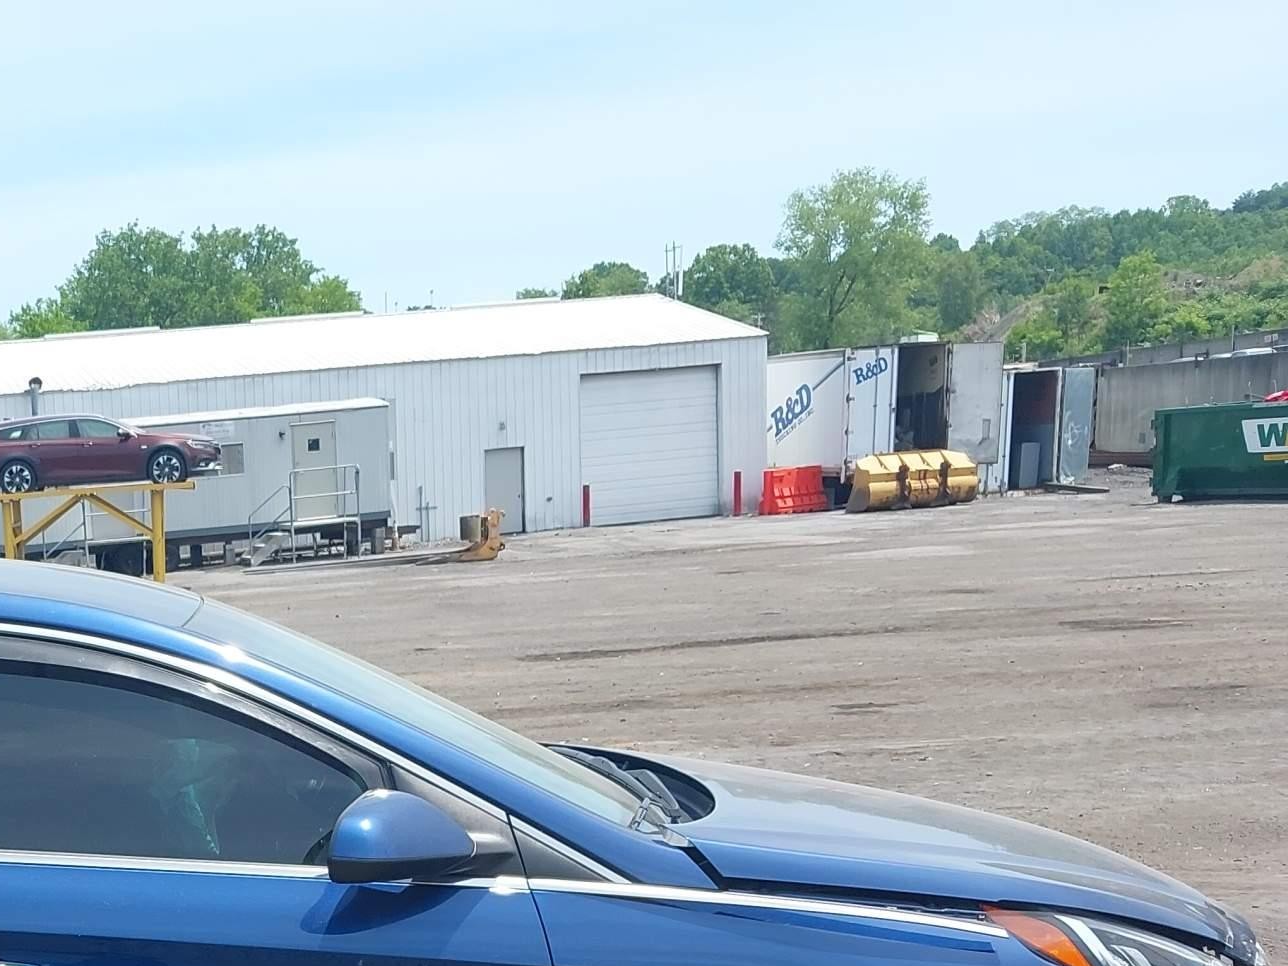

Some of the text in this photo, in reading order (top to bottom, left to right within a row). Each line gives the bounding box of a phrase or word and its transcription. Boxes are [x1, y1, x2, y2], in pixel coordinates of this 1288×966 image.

[852, 357, 888, 385] R&D
[771, 384, 812, 438] R&D
[1257, 423, 1288, 447] W
